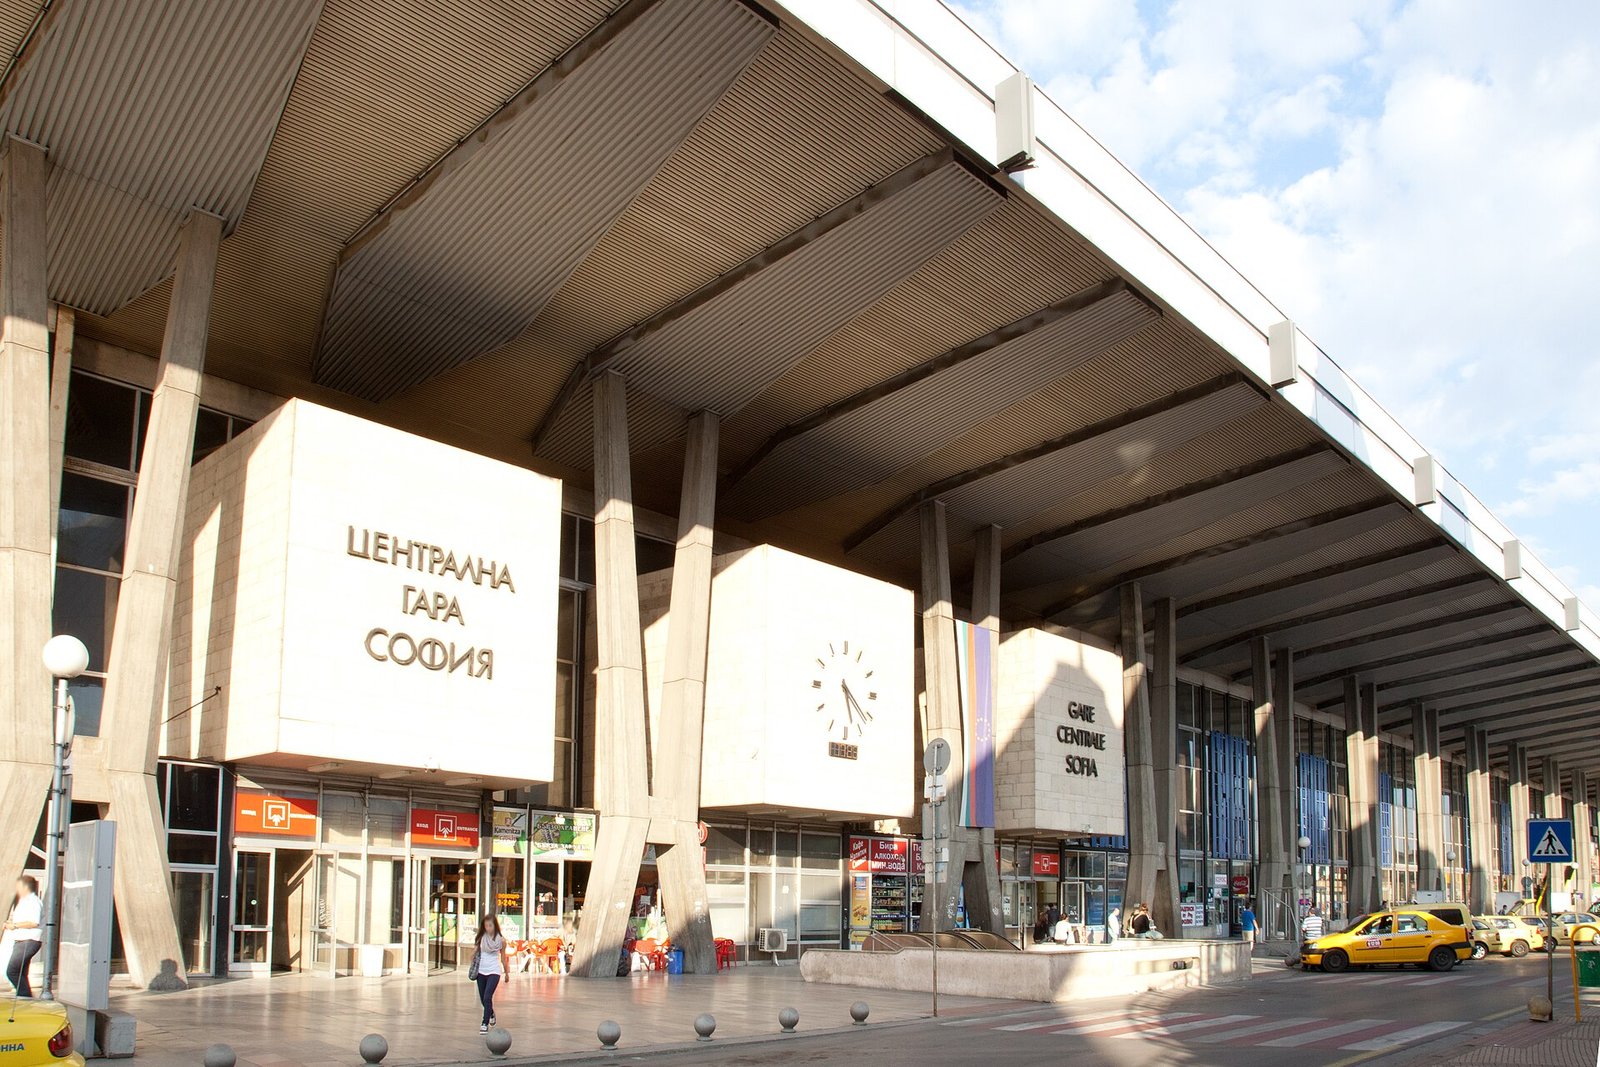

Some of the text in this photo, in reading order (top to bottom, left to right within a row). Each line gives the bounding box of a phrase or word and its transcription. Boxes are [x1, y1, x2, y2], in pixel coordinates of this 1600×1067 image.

[347, 525, 515, 593] ЦЕНТРАЛНА
[403, 585, 465, 626] ГАРА
[364, 628, 493, 680] СОФИЯ
[1068, 701, 1095, 723] GARE
[1057, 725, 1106, 751] CENTRALE
[1066, 755, 1098, 778] SOFIA
[494, 827, 521, 835] Kamenitza
[879, 841, 898, 851] Бира
